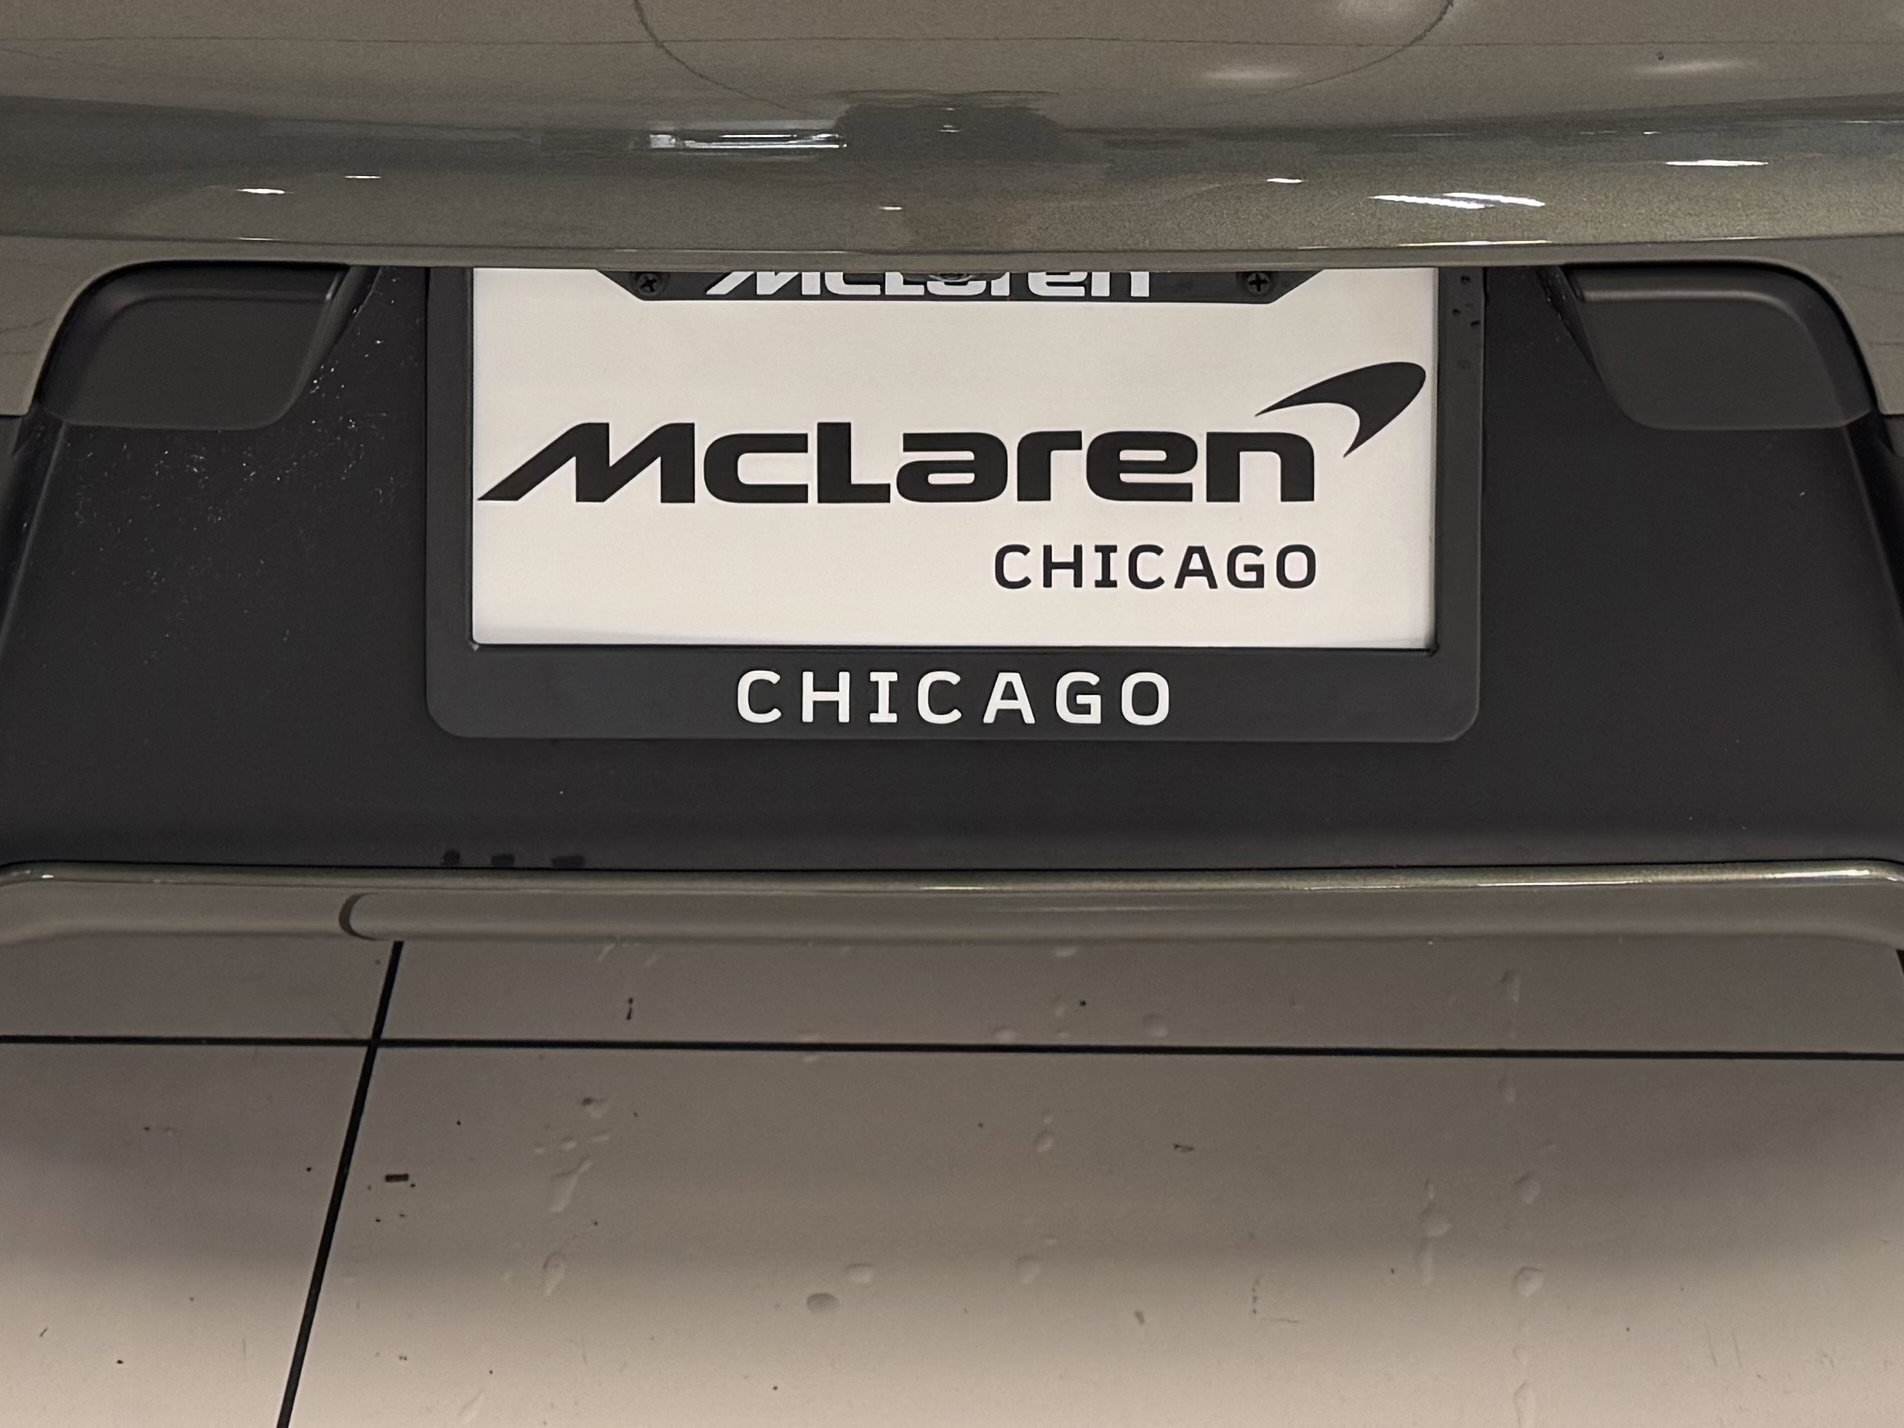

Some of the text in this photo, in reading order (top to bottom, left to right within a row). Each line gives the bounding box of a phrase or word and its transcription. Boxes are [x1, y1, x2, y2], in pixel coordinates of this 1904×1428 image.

[477, 421, 1316, 504] McLaren
[994, 544, 1317, 590] CHICAGO
[736, 670, 1171, 726] CHICAGO
